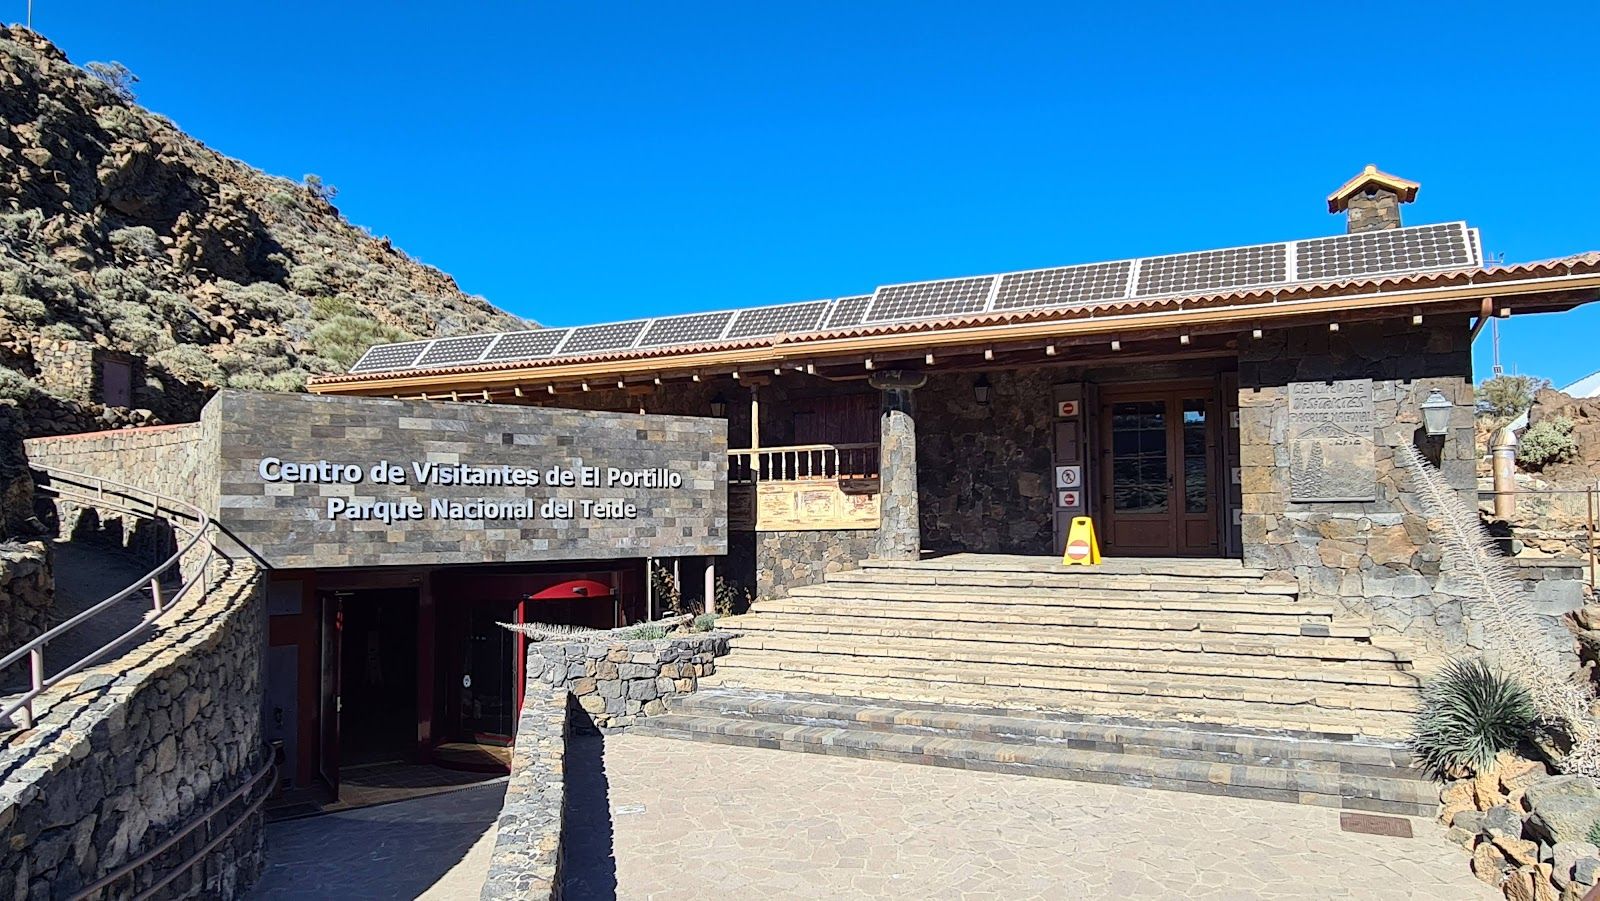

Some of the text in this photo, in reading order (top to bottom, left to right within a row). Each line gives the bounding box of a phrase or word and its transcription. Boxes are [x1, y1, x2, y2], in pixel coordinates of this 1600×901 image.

[1348, 383, 1364, 394] DE
[259, 457, 683, 488] Centro de Visitantes de El Portillo
[327, 498, 638, 525] Parque Nacional del Teide
